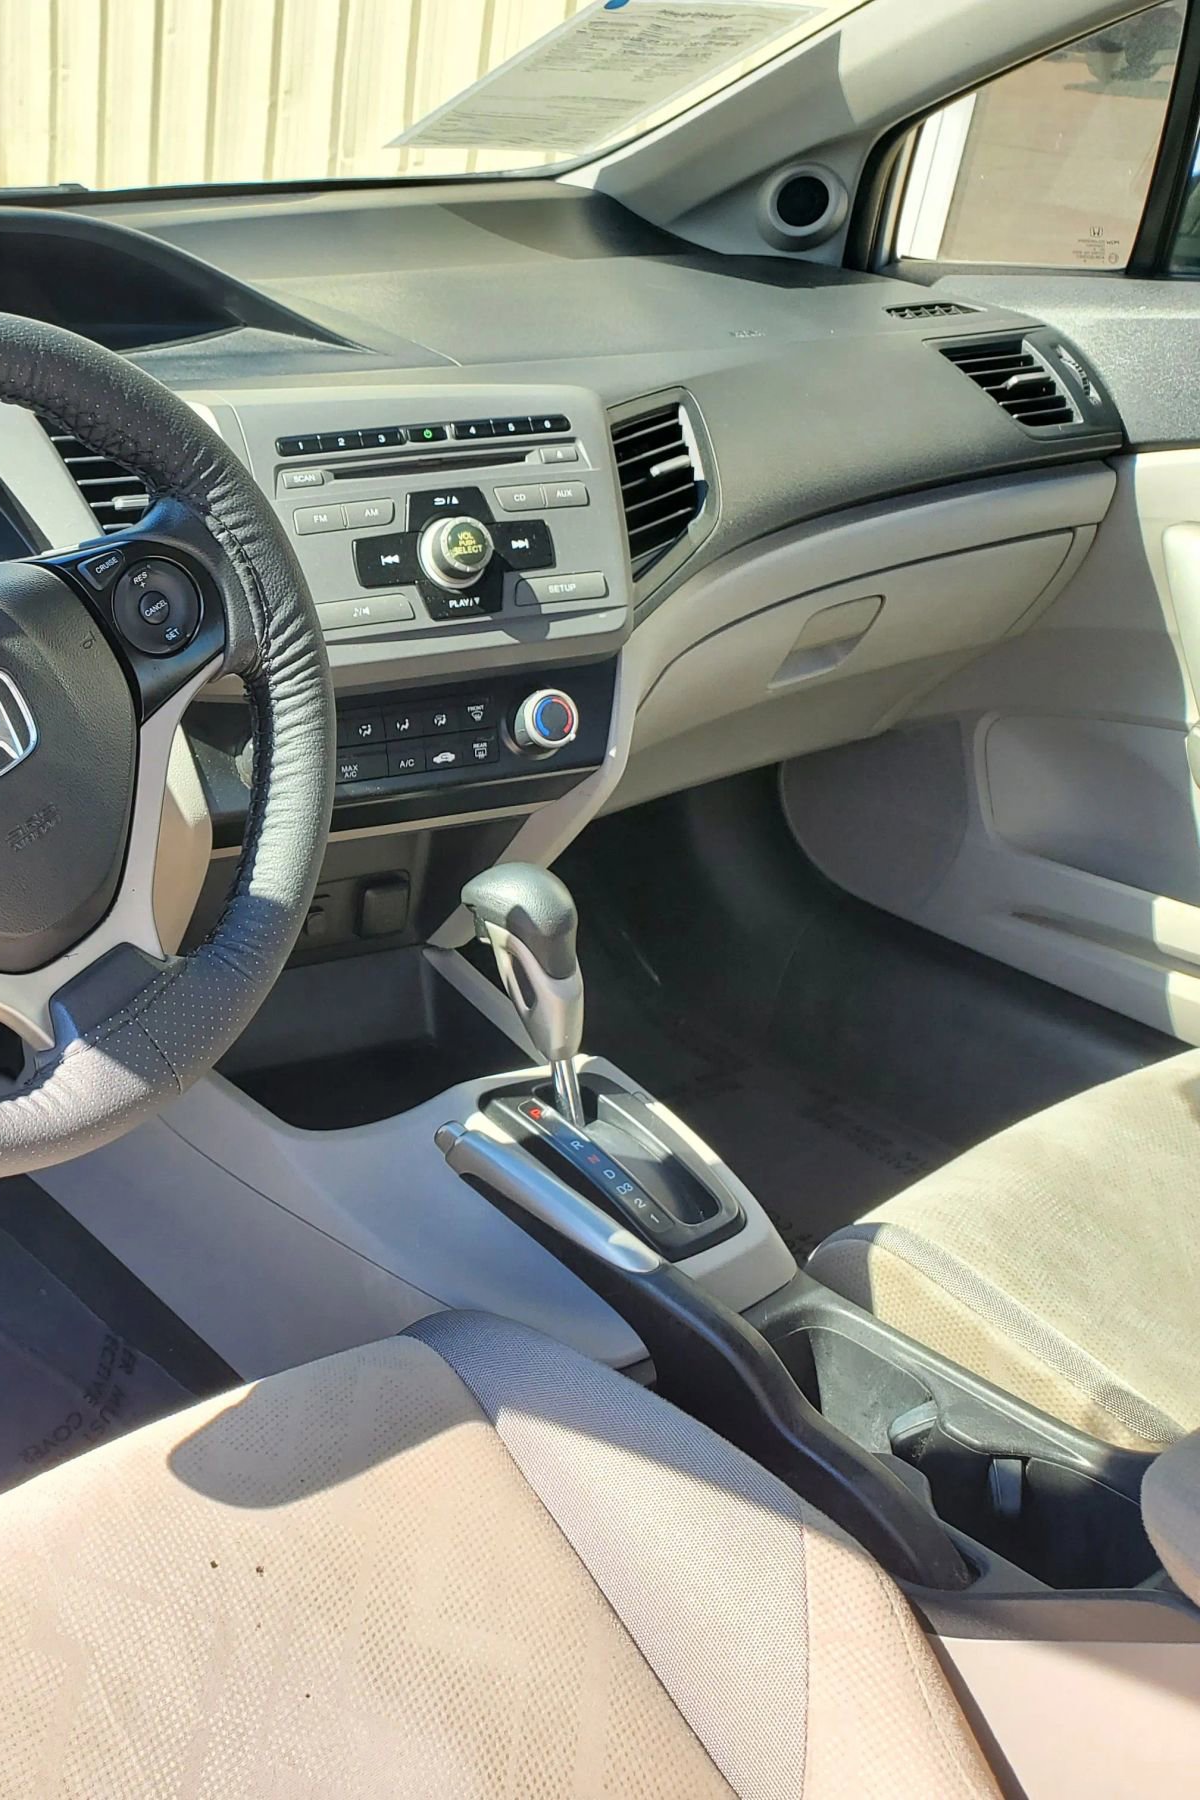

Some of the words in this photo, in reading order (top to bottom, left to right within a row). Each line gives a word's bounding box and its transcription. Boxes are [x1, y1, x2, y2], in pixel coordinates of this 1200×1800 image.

[293, 474, 316, 483] SCAN
[513, 493, 526, 501] CD
[556, 488, 573, 498] AUX
[364, 508, 379, 517] AM
[313, 514, 328, 524] FM
[457, 532, 474, 541] VOL
[453, 545, 483, 555] SELECT
[95, 556, 119, 574] CRUISE
[133, 571, 148, 584] RES
[548, 584, 577, 593] SETUP
[144, 599, 168, 617] CANCEL
[165, 628, 181, 641] SET
[341, 764, 359, 773] MAX
[399, 759, 416, 768] A/C
[344, 771, 357, 779] A/C
[529, 1107, 542, 1120] P
[570, 1140, 584, 1151] R
[603, 1169, 616, 1180] D
[616, 1182, 634, 1196] D3
[633, 1198, 647, 1209] 2
